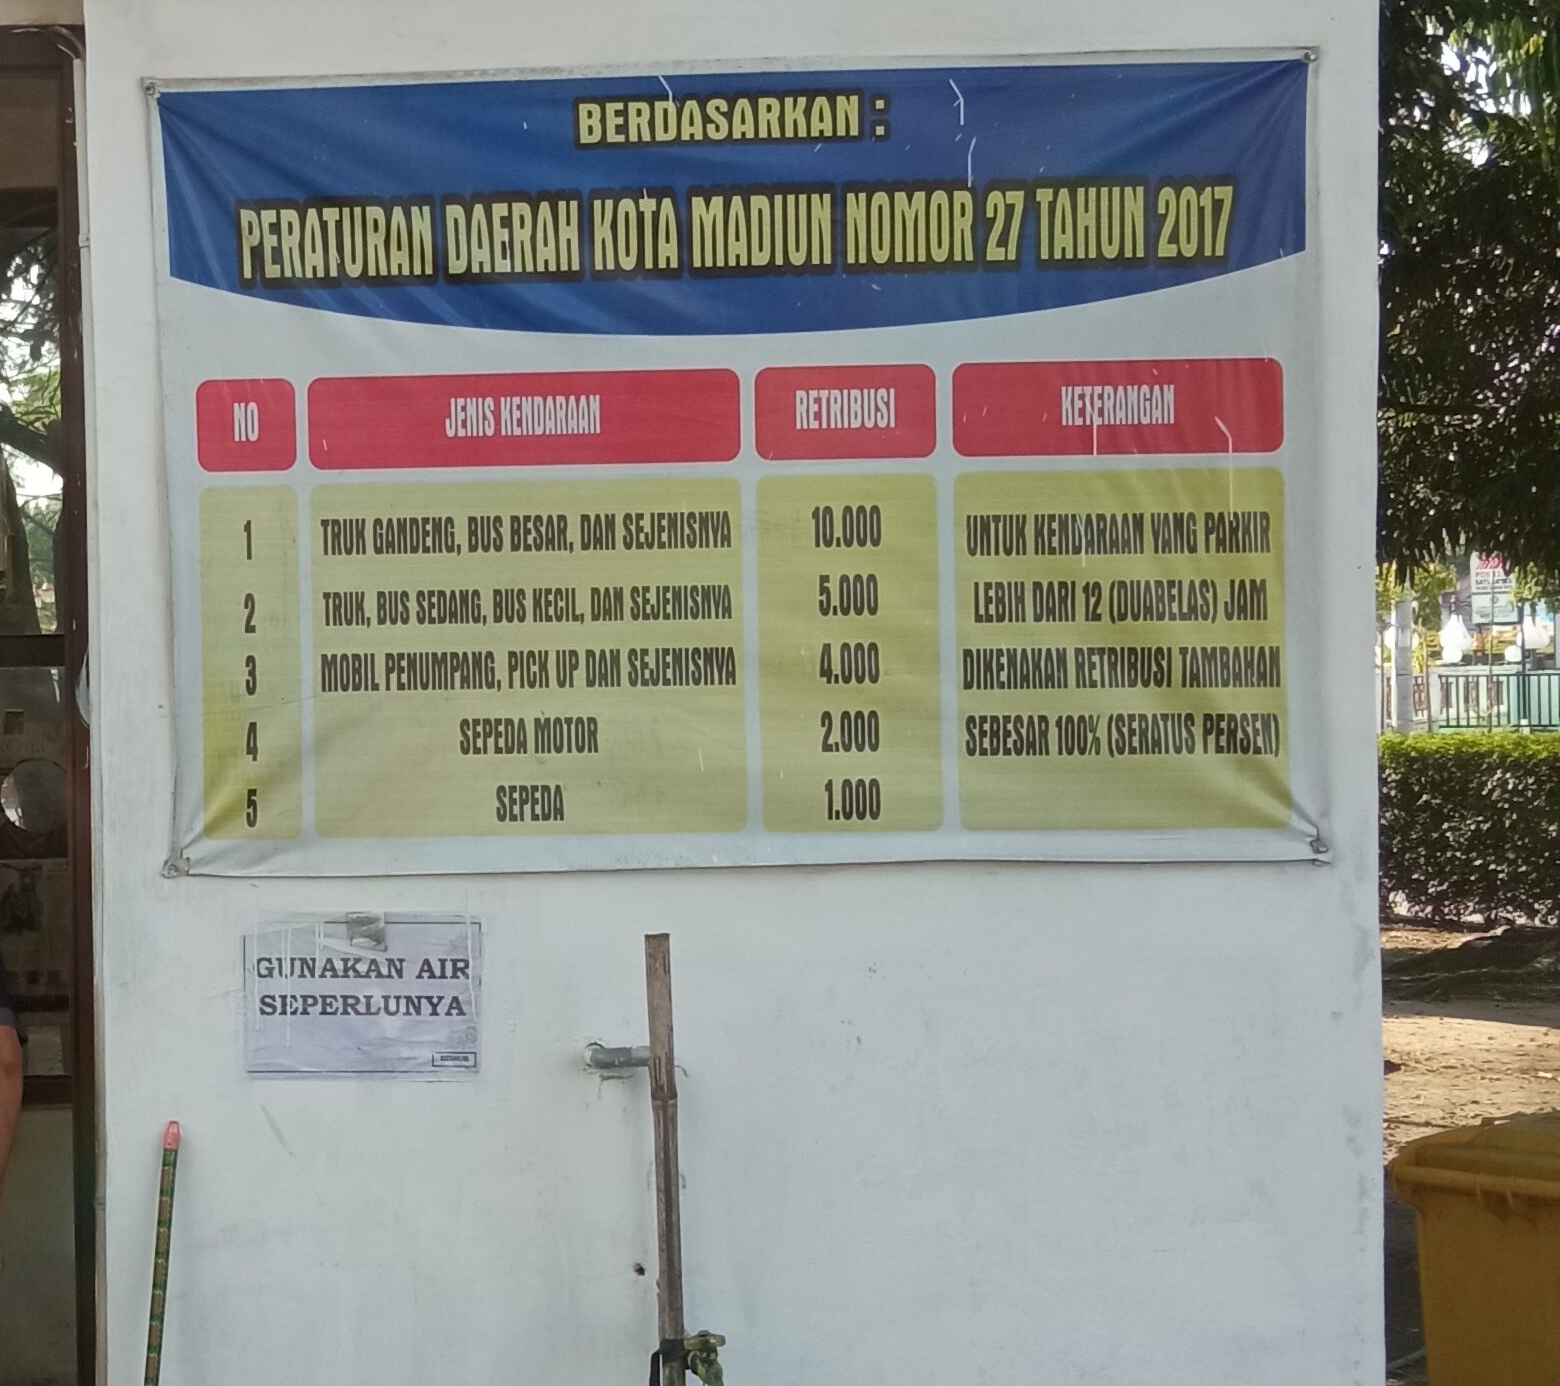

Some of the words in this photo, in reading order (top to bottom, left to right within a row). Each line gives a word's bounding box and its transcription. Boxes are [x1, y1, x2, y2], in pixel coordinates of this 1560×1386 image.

[577, 94, 861, 144] BERDASARKAN
[874, 98, 887, 137] :
[239, 205, 434, 280] PERATURAN
[446, 200, 581, 275] DAERAH
[593, 196, 678, 271] KOTA
[690, 192, 832, 269] MADIUN
[845, 189, 974, 265] NOMOR
[984, 188, 1026, 263] 27
[1035, 186, 1145, 260] TAHUN
[1156, 185, 1234, 258] 2017
[233, 401, 260, 443] NO
[444, 395, 496, 438] JENIS
[500, 393, 601, 437] KENDARAAN
[795, 388, 896, 430] RETRIBUSI
[1060, 384, 1176, 426] KETERANGAN
[242, 519, 253, 561] 1
[320, 518, 367, 556] TRUK
[372, 514, 462, 557] GANDENG,
[467, 514, 505, 553] BUS
[509, 513, 574, 555] BESAR,
[580, 511, 616, 552] DAN
[622, 509, 732, 551] SEJENISNYA
[811, 504, 882, 549] 10.000
[966, 513, 1028, 557] UNTUK
[1033, 512, 1145, 556] KENDARAAN
[1150, 511, 1198, 555] YANG
[1204, 510, 1272, 554] PARKIR
[243, 593, 257, 634] 2
[322, 589, 372, 631] TRUK,
[376, 589, 412, 626] BUS
[415, 587, 488, 627] SEDANG,
[492, 586, 527, 624] BUS
[532, 585, 585, 626] KECIL,
[590, 585, 625, 622] DAN
[629, 583, 733, 621] SEJENISNYA
[818, 573, 879, 618] 5.000
[973, 581, 1027, 624] LEBIH
[1032, 580, 1076, 623] DARI
[1082, 579, 1103, 622] 12
[1109, 579, 1218, 625] (DUABELAS)
[1223, 578, 1268, 621] JAM
[244, 654, 258, 696] 3
[320, 652, 380, 693] MOBIL
[384, 649, 502, 693] PENUMPANG,
[507, 649, 550, 690] PICK
[554, 649, 580, 689] UP
[585, 647, 621, 688] DAN
[627, 645, 737, 687] SEJENISNYA
[819, 641, 880, 685] 4.000
[962, 646, 1068, 690] DIKENAKAN
[1074, 645, 1172, 689] RETRIBUSI
[1178, 645, 1281, 688] TAMBAHAN
[245, 721, 259, 762] 4
[459, 718, 527, 756] SEPEDA
[533, 715, 599, 755] MOTOR
[820, 709, 880, 753] 2.000
[965, 715, 1049, 757] SEBESAR
[1055, 714, 1100, 757] 100%
[1106, 712, 1196, 758] (SERATUS
[1201, 712, 1280, 757] PERSEN)
[245, 788, 259, 828] 5
[495, 784, 565, 822] SEPEDA
[824, 778, 881, 821] 1.000
[256, 956, 406, 980] GUNAKAN
[415, 957, 470, 980] AIR
[259, 994, 467, 1017] SEPERLUNYA
